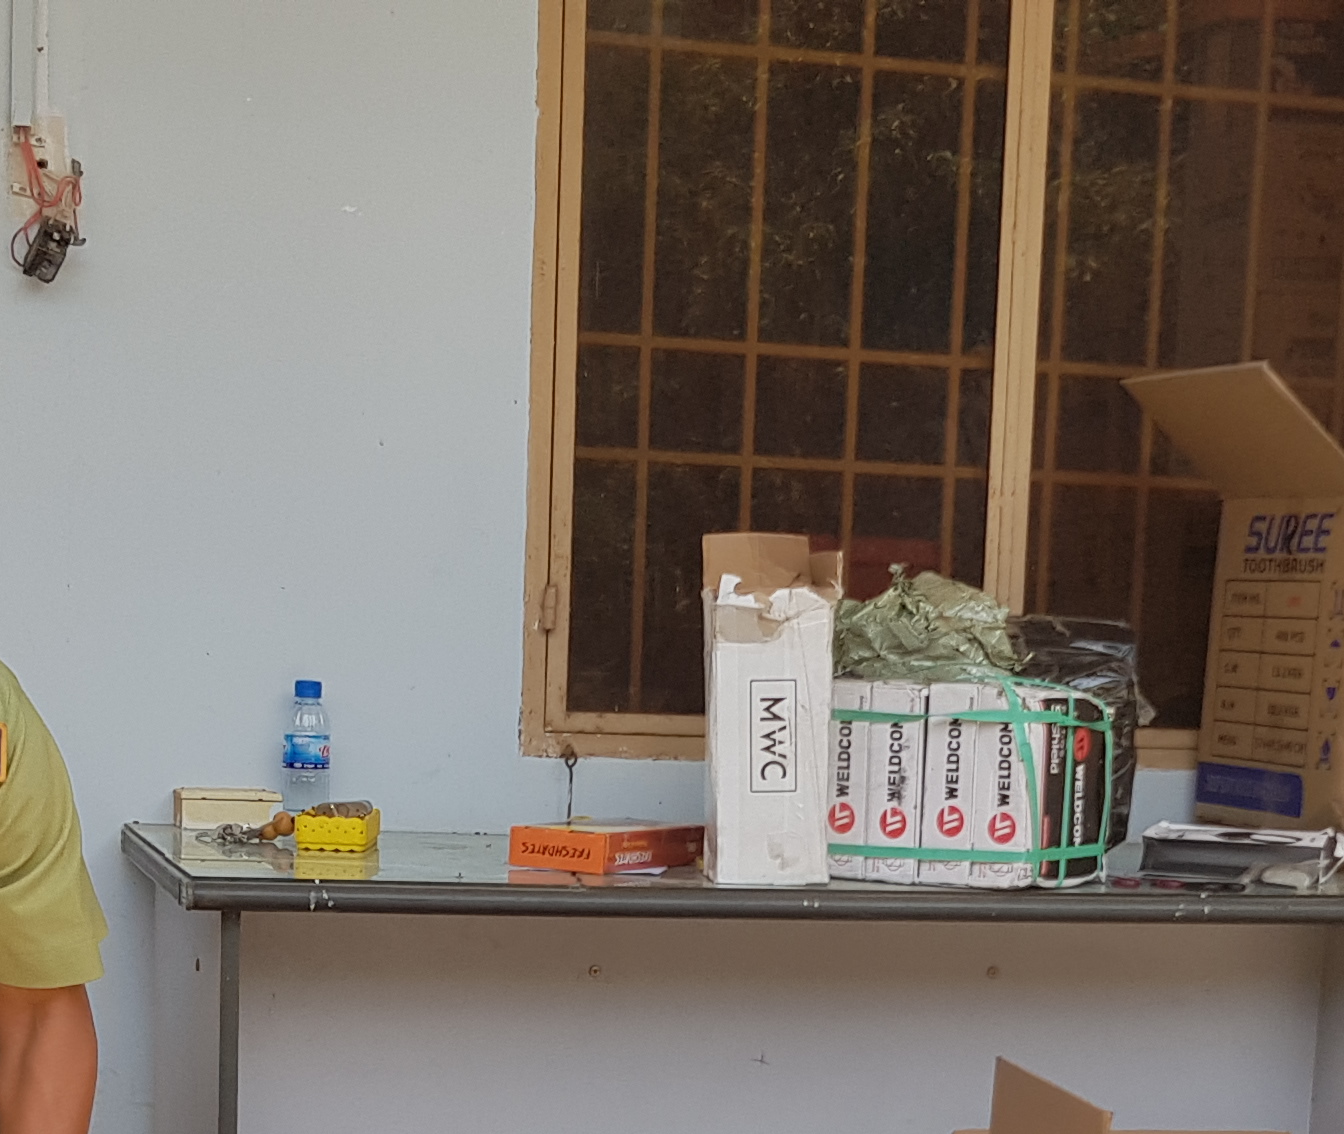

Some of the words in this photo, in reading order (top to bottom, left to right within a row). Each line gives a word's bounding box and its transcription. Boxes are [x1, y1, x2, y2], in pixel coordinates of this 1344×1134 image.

[1243, 558, 1325, 574] TOOTHBRUSH
[759, 696, 787, 782] MWC
[521, 840, 592, 861] FRESHDATES
